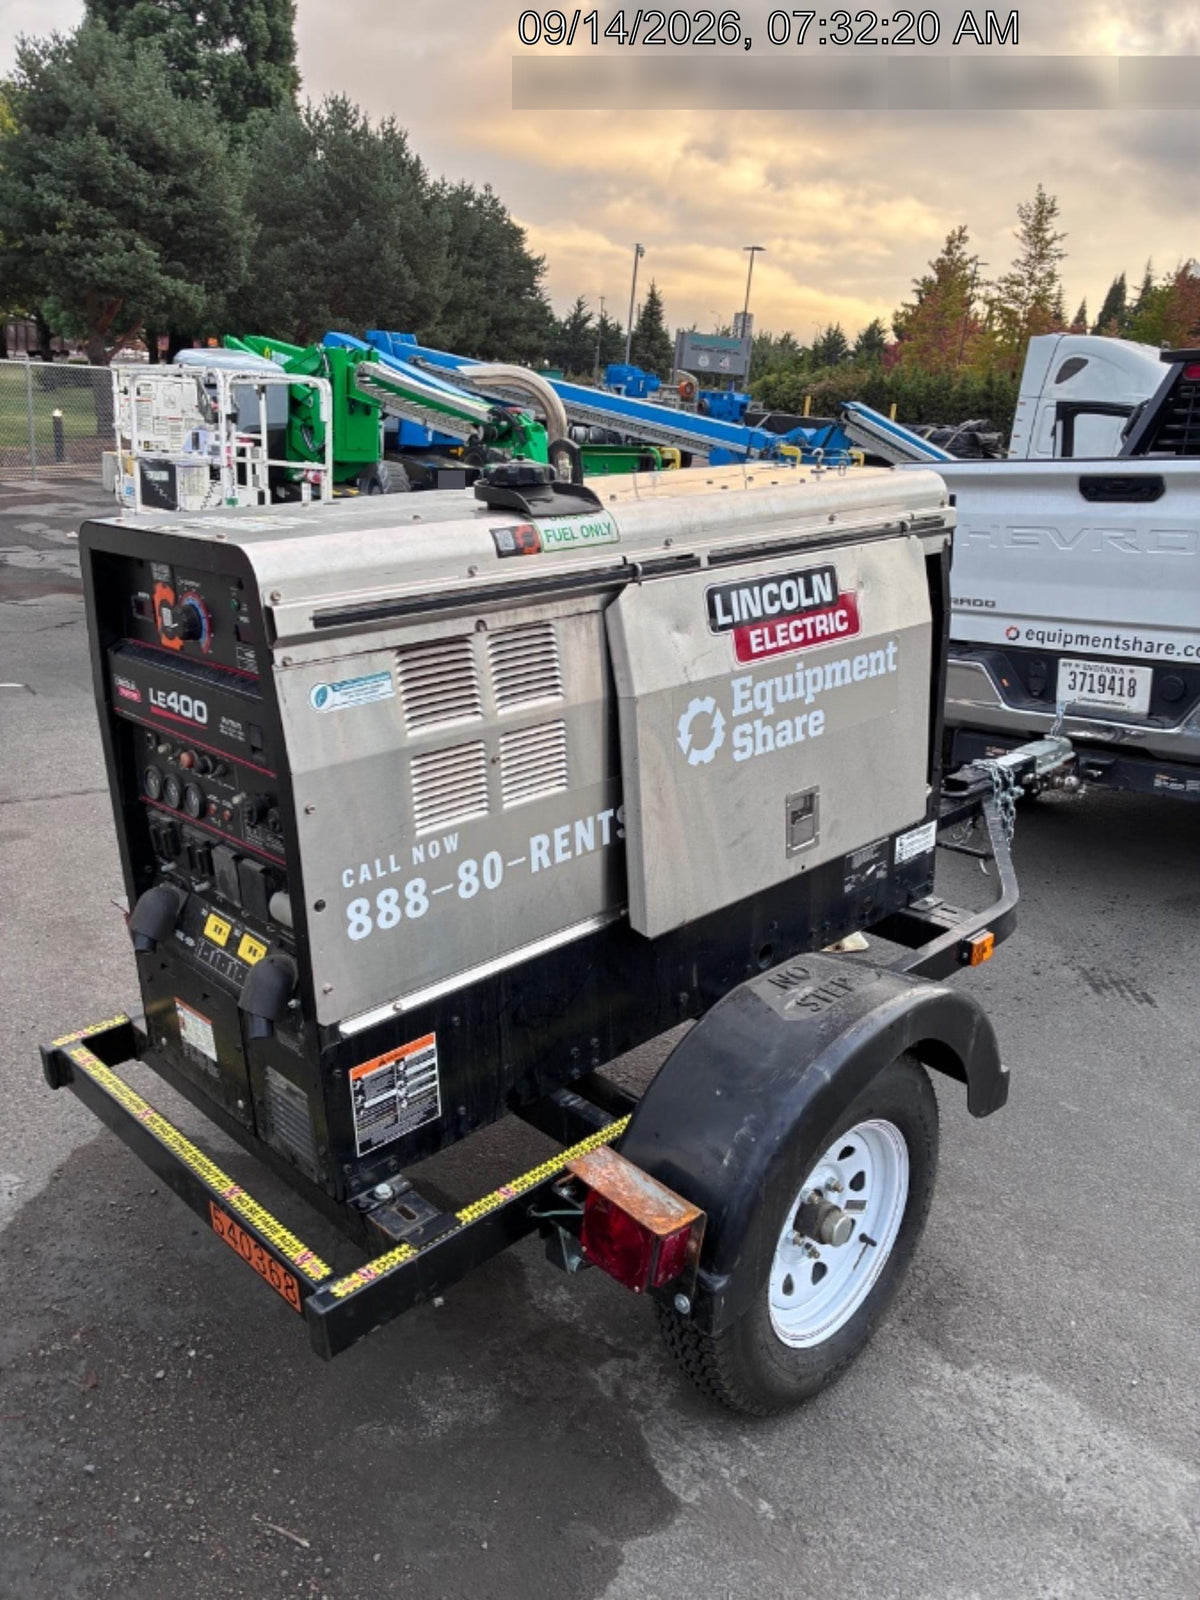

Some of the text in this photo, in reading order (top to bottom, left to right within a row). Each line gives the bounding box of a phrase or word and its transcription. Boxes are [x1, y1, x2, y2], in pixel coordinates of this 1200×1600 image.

[544, 522, 612, 543] FUEL ONLY
[959, 523, 1198, 556] HEVRO
[714, 571, 834, 626] LINCOLN
[951, 596, 997, 609] RADO
[749, 609, 849, 654] ELECTRIC
[731, 640, 899, 718] Equipment
[1067, 670, 1138, 698] 3719418
[148, 687, 208, 724] LE400
[731, 708, 826, 763] Share
[341, 832, 460, 889] CALL NOW
[767, 965, 812, 991] NO
